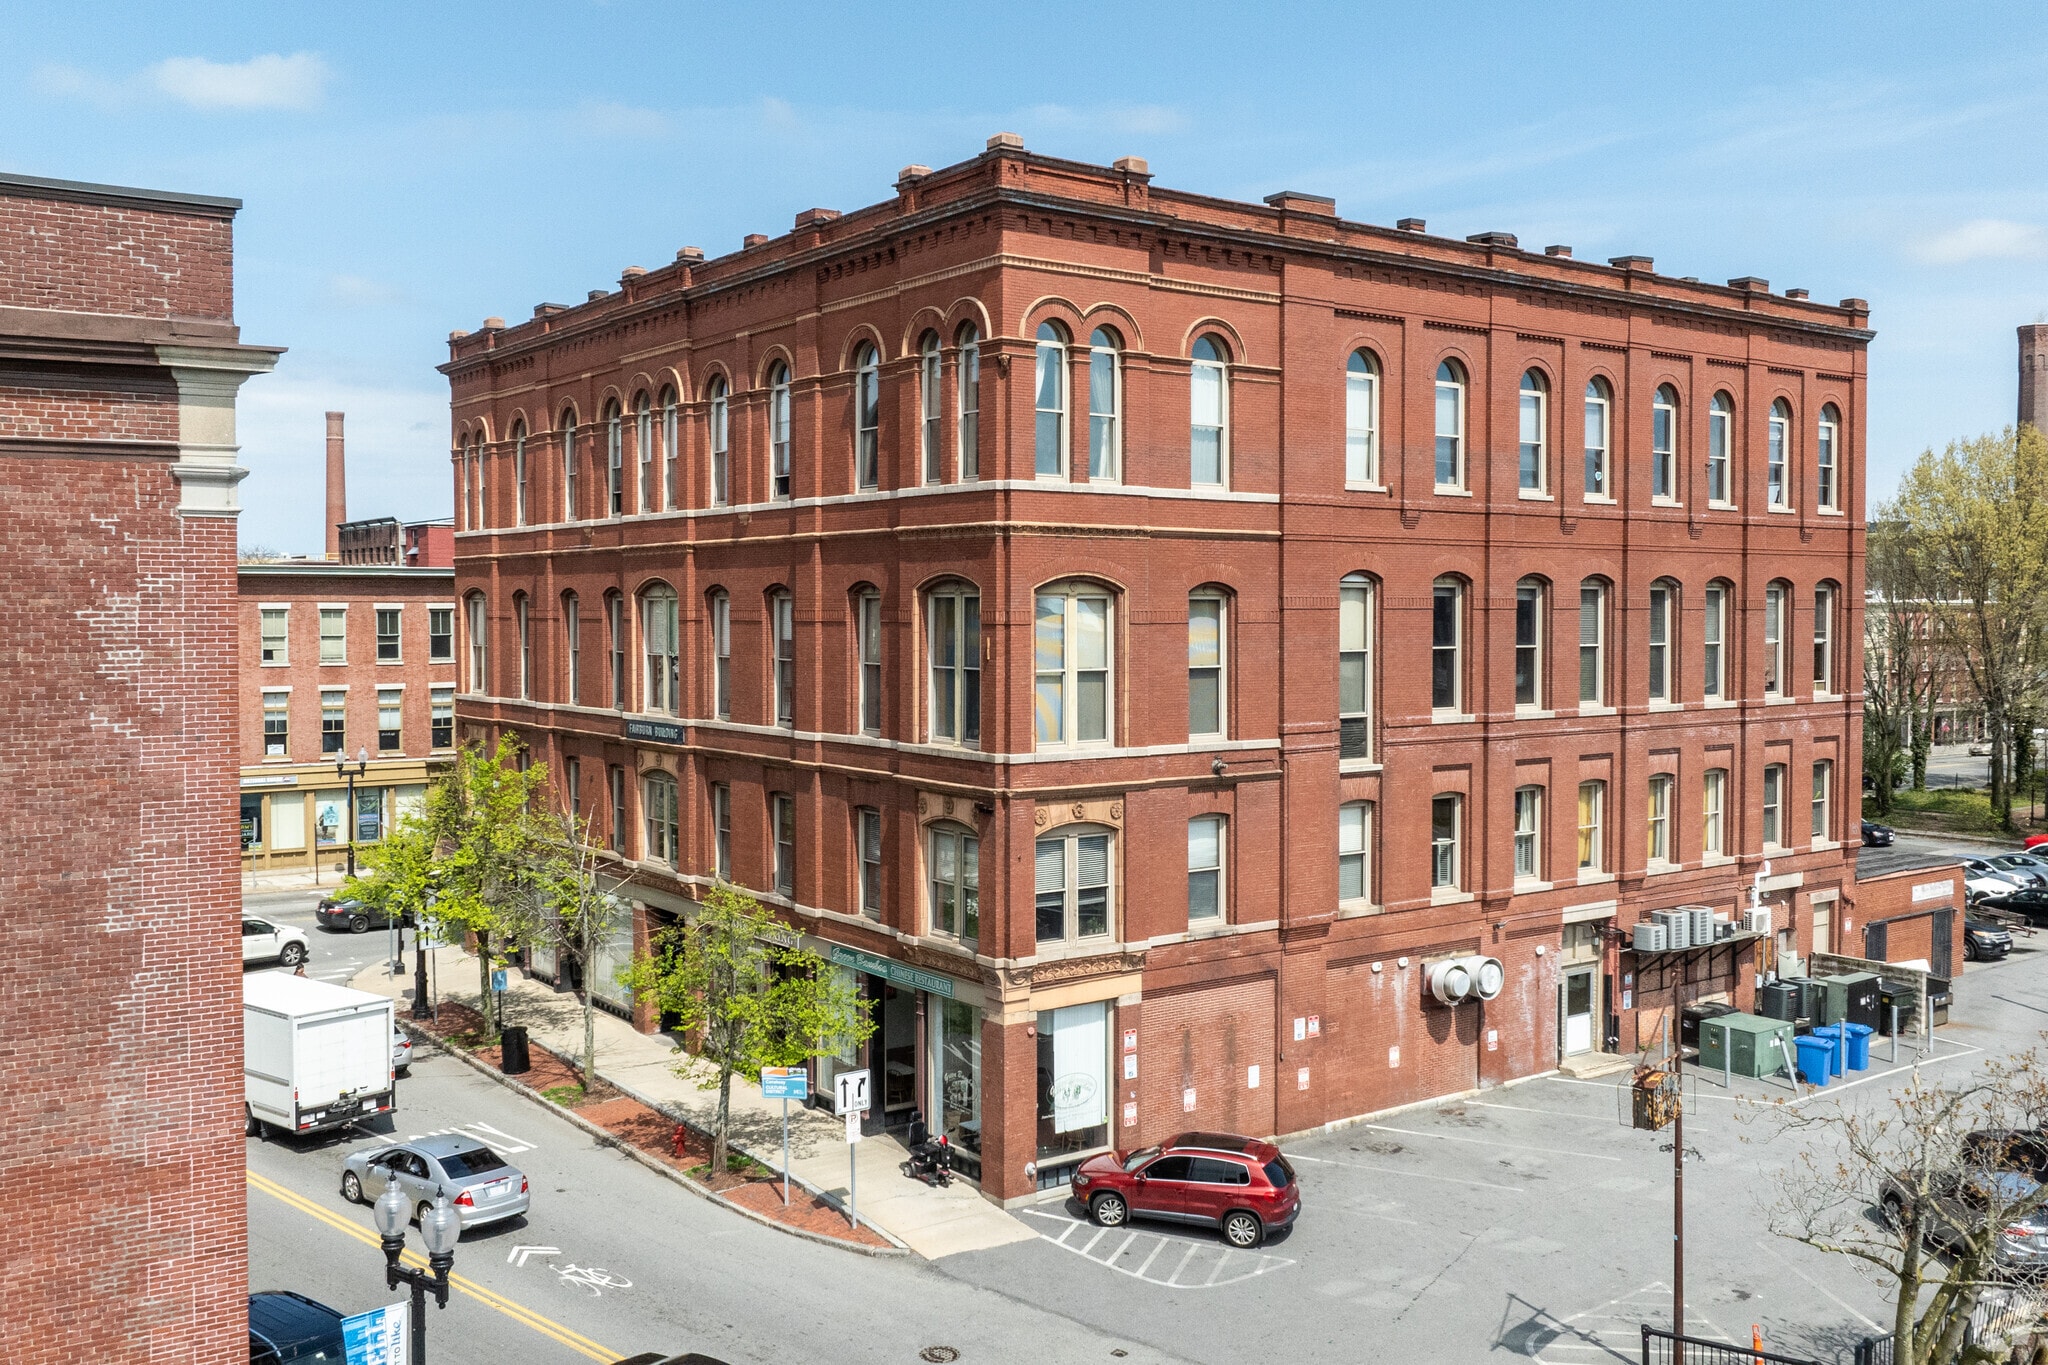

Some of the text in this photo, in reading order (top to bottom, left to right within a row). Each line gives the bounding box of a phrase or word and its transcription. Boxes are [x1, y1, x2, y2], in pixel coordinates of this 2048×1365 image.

[629, 723, 678, 739] FAIRBURN BUILDING
[890, 966, 952, 994] CHINESE RESTAURANT
[854, 1099, 868, 1108] ONLY
